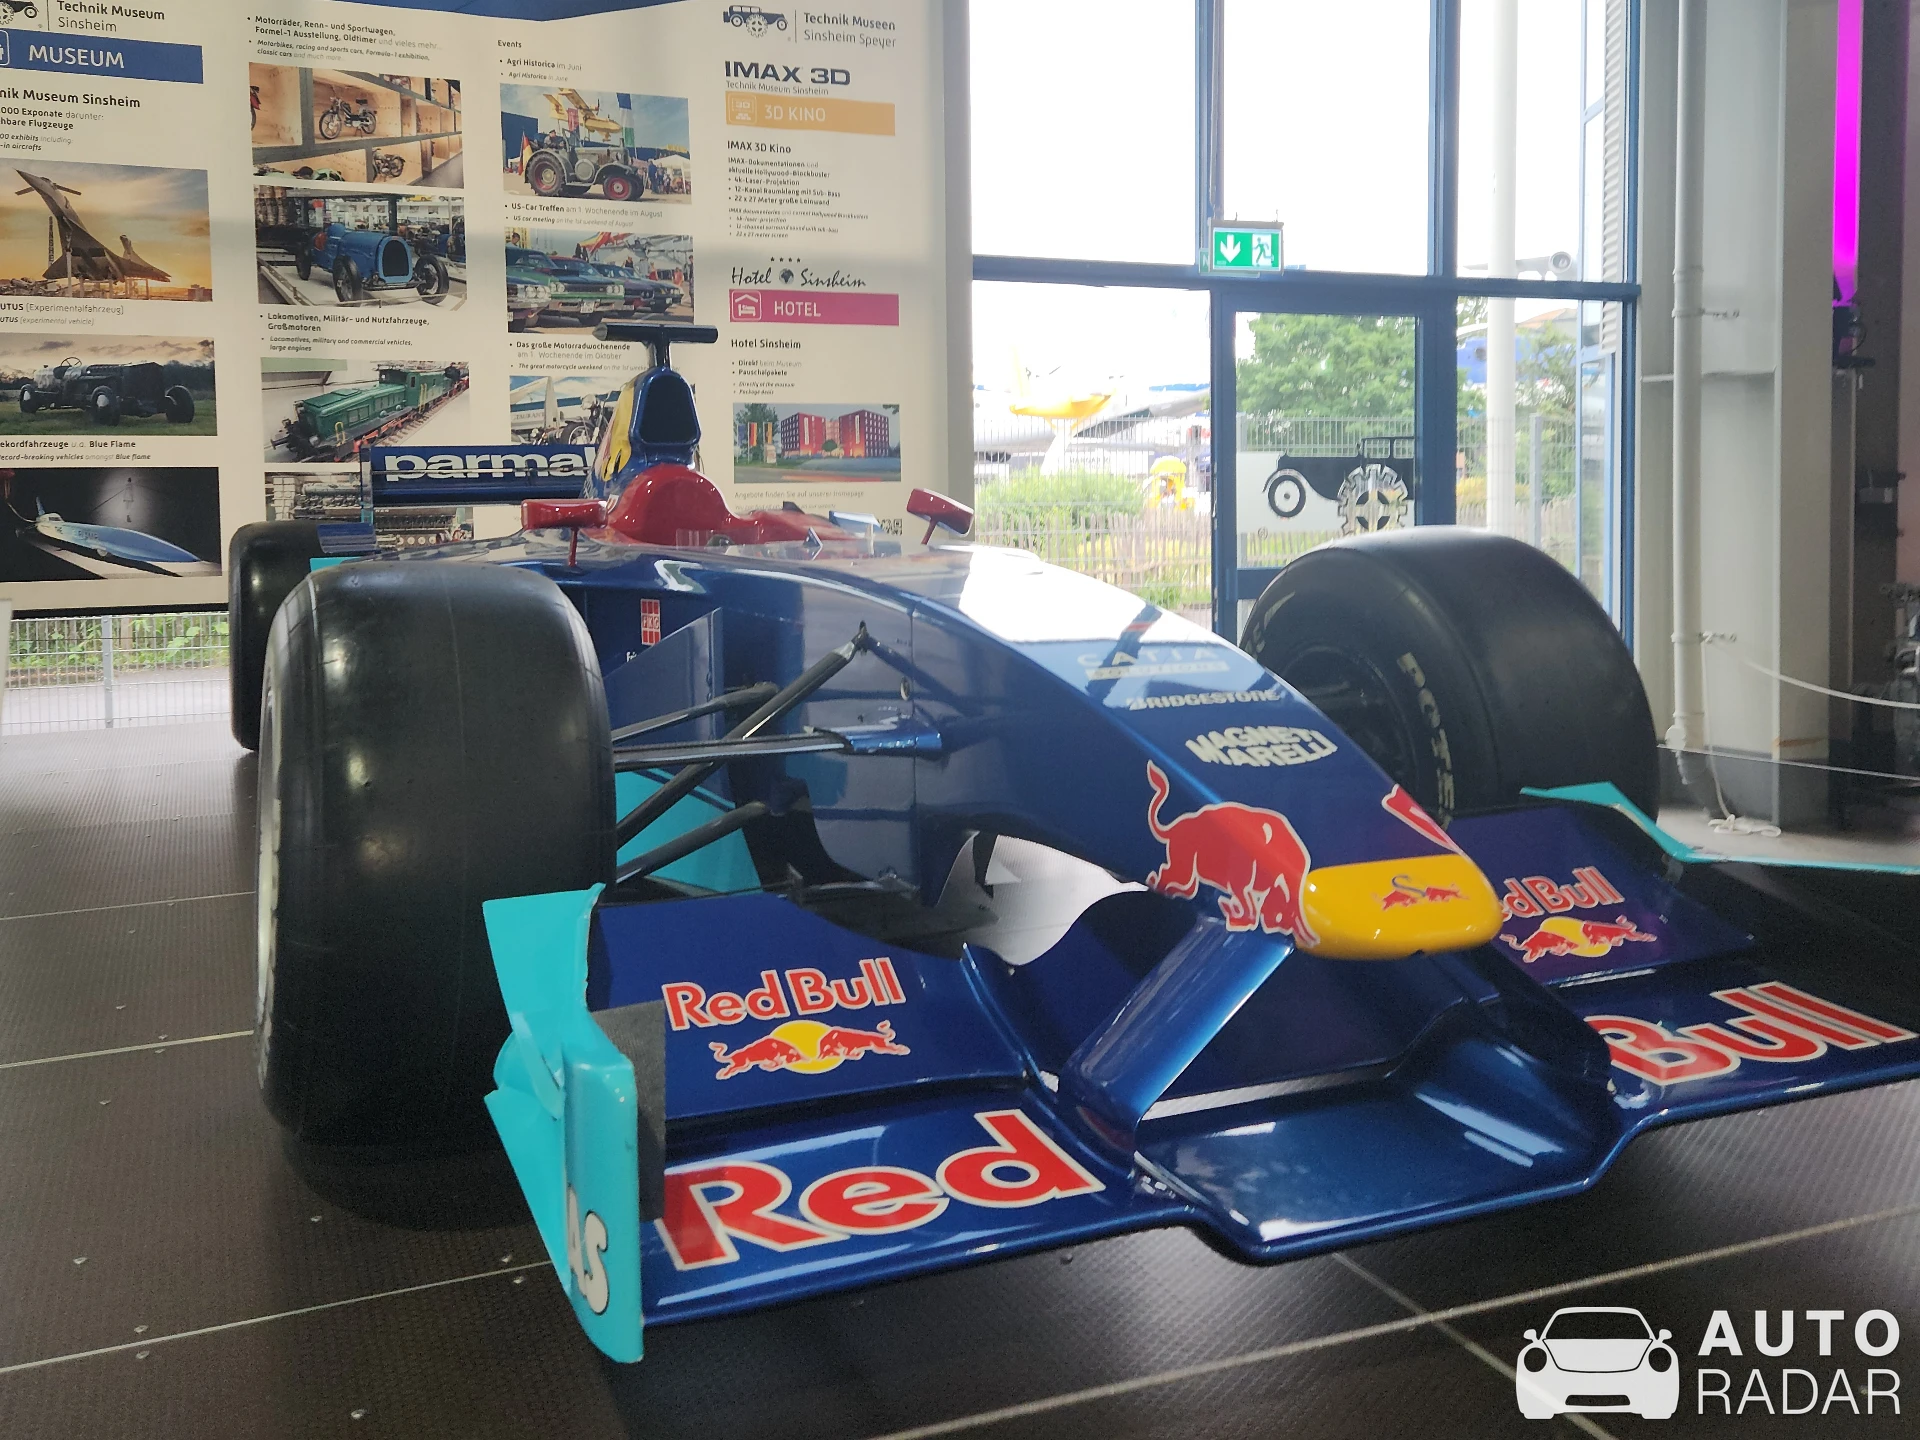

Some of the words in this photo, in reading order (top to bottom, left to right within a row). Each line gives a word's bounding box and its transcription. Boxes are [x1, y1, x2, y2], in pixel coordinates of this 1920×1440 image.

[56, 0, 108, 15] Technik
[111, 7, 165, 20] Museum
[58, 17, 117, 32] Sinsheim
[255, 16, 302, 28] Motorräder,
[304, 20, 329, 28] Renn-
[347, 24, 396, 36] Sportwagen,
[804, 12, 849, 26] Technik
[852, 15, 896, 31] Museen
[255, 26, 291, 36] Formel-1
[294, 30, 341, 41] Ausstellung,
[343, 34, 376, 43] Oldtimer
[804, 30, 856, 43] Sinsheim
[859, 35, 896, 49] Speyer
[257, 39, 294, 49] Motorbikes,
[497, 40, 522, 48] Events
[29, 45, 124, 68] MUSEUM
[257, 48, 278, 56] classic
[507, 58, 522, 66] Agri
[523, 59, 556, 68] Historica
[725, 61, 802, 83] IMAX
[810, 68, 851, 86] 3D
[727, 80, 757, 90] Technik
[759, 83, 791, 93] Museum
[793, 85, 829, 95] Sinsheim
[23, 89, 79, 103] Museum
[82, 94, 141, 108] Sinsheim
[22, 108, 63, 118] Exponate
[65, 111, 104, 120] darunter:
[764, 104, 783, 120] 3D
[788, 107, 826, 121] KINO
[29, 119, 74, 131] Flugzeuge
[11, 134, 39, 142] exhibits
[12, 143, 42, 152] aircrafts
[727, 140, 752, 151] IMAX
[755, 143, 767, 152] 3D
[769, 144, 792, 154] Kino
[511, 203, 537, 211] US-Car
[539, 204, 565, 212] Treffen
[585, 206, 629, 216] Wochenende
[640, 209, 663, 218] August
[732, 266, 772, 286] Hotel
[800, 268, 866, 288] Sinsheim
[774, 301, 821, 317] HOTEL
[267, 312, 321, 322] Lokomotiven,
[372, 316, 430, 326] Nutzfahrzeuge,
[267, 323, 322, 332] Großmotoren
[270, 335, 311, 344] Locomotives,
[312, 337, 336, 345] military
[516, 341, 530, 349] Das
[531, 342, 552, 350] große
[553, 342, 631, 350] Motorradwochenende
[731, 338, 757, 348] Hotel
[760, 338, 801, 349] Sinsheim
[270, 344, 286, 352] large
[538, 351, 583, 359] Wochenende
[595, 352, 622, 360] Oktober
[0, 440, 69, 450] ekordfahrzeuge
[89, 440, 108, 448] Blue
[110, 440, 136, 448] Flame
[642, 615, 660, 629] FKG
[1127, 689, 1280, 711] BRIDGESTONE
[1521, 865, 1625, 914] Bull
[662, 970, 788, 1031] Red
[785, 957, 906, 1016] Bull
[1583, 981, 1919, 1086] Bull
[654, 1108, 1107, 1271] Red
